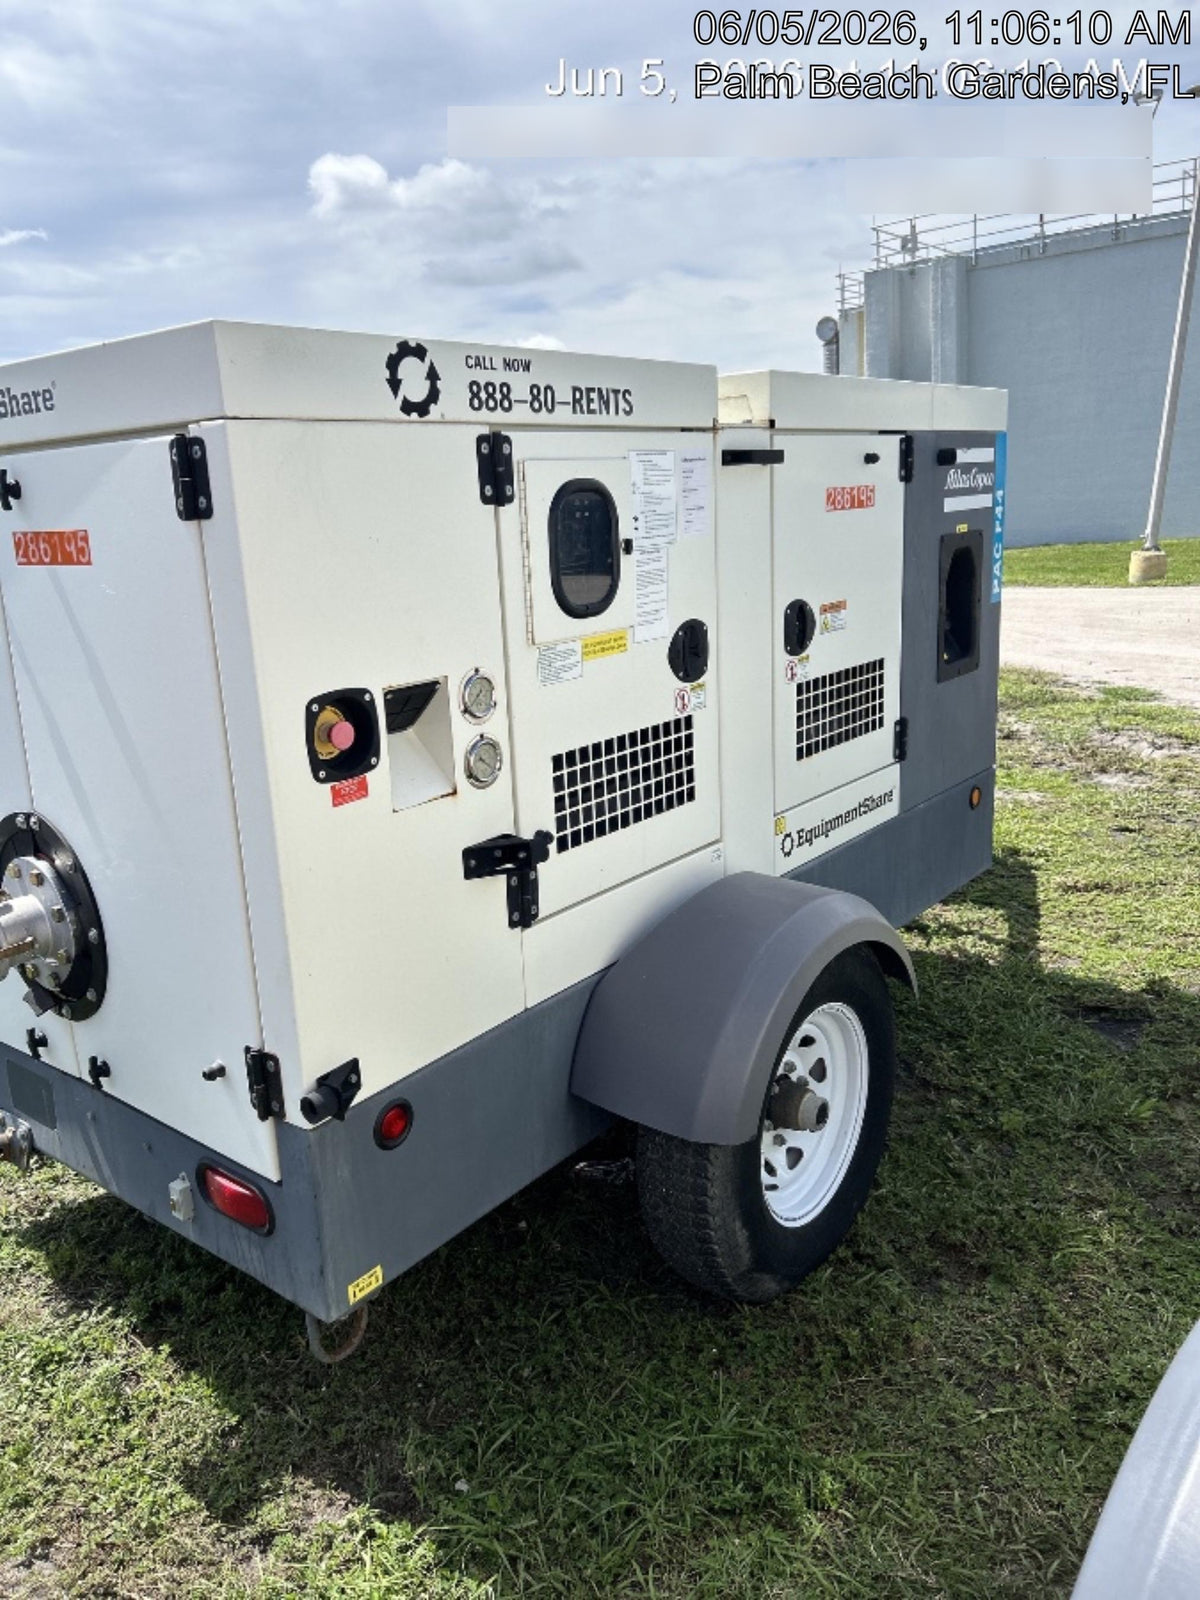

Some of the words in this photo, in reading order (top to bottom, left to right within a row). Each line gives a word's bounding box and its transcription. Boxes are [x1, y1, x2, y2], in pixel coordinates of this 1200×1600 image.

[465, 354, 497, 371] CALL
[502, 357, 532, 373] NOW
[468, 380, 634, 416] 888-80-RENTS
[944, 468, 970, 490] Atlas
[970, 467, 995, 491] Copco
[825, 485, 875, 511] 286195
[15, 530, 90, 564] 286195
[796, 788, 894, 848] EquipmentShare
